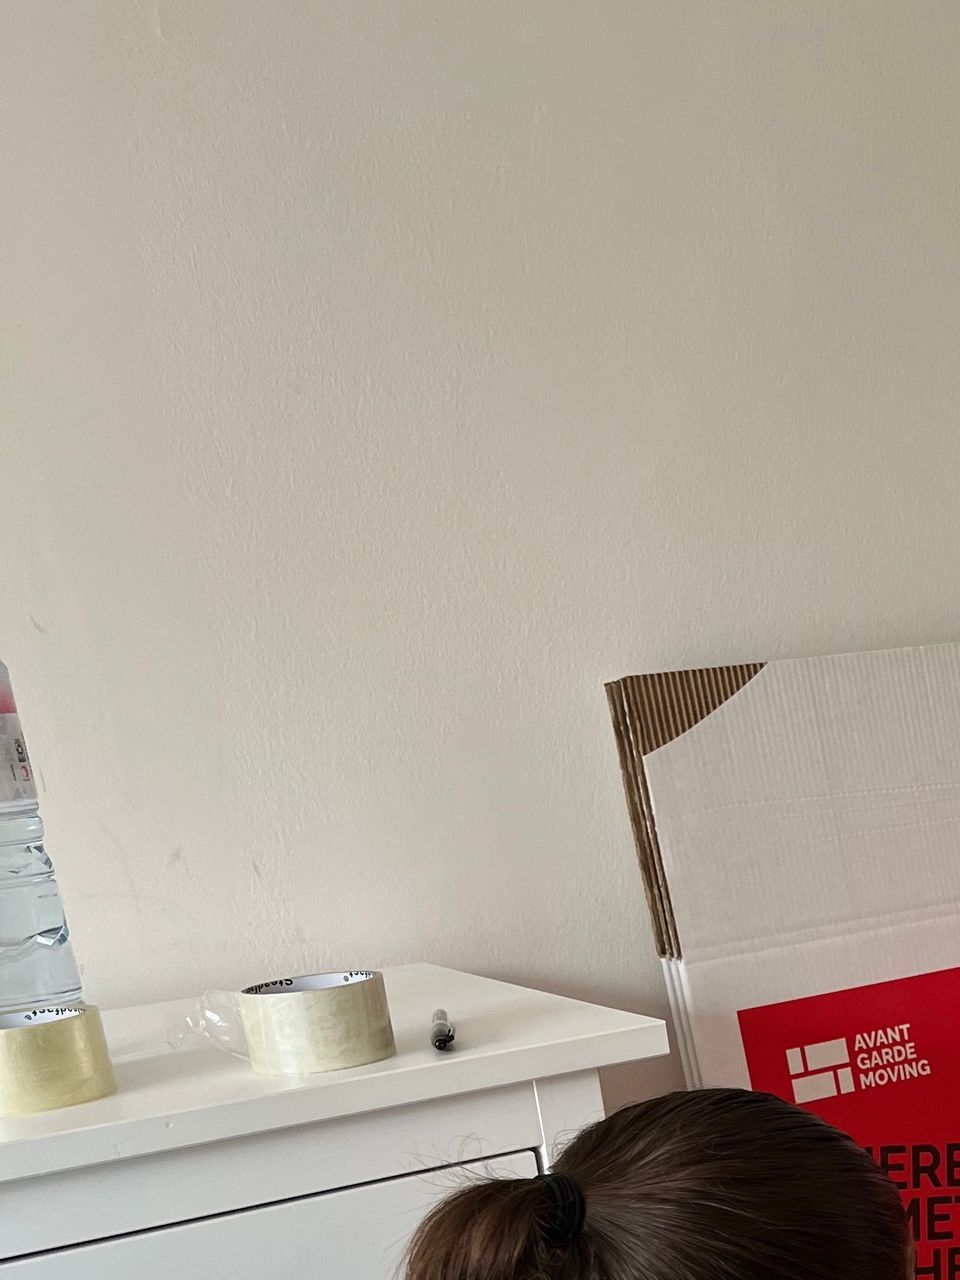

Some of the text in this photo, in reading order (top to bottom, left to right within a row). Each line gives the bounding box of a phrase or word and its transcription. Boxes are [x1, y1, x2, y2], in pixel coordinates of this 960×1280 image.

[854, 1024, 911, 1051] AVANT
[856, 1042, 917, 1070] GARDE
[859, 1059, 931, 1089] MOVING
